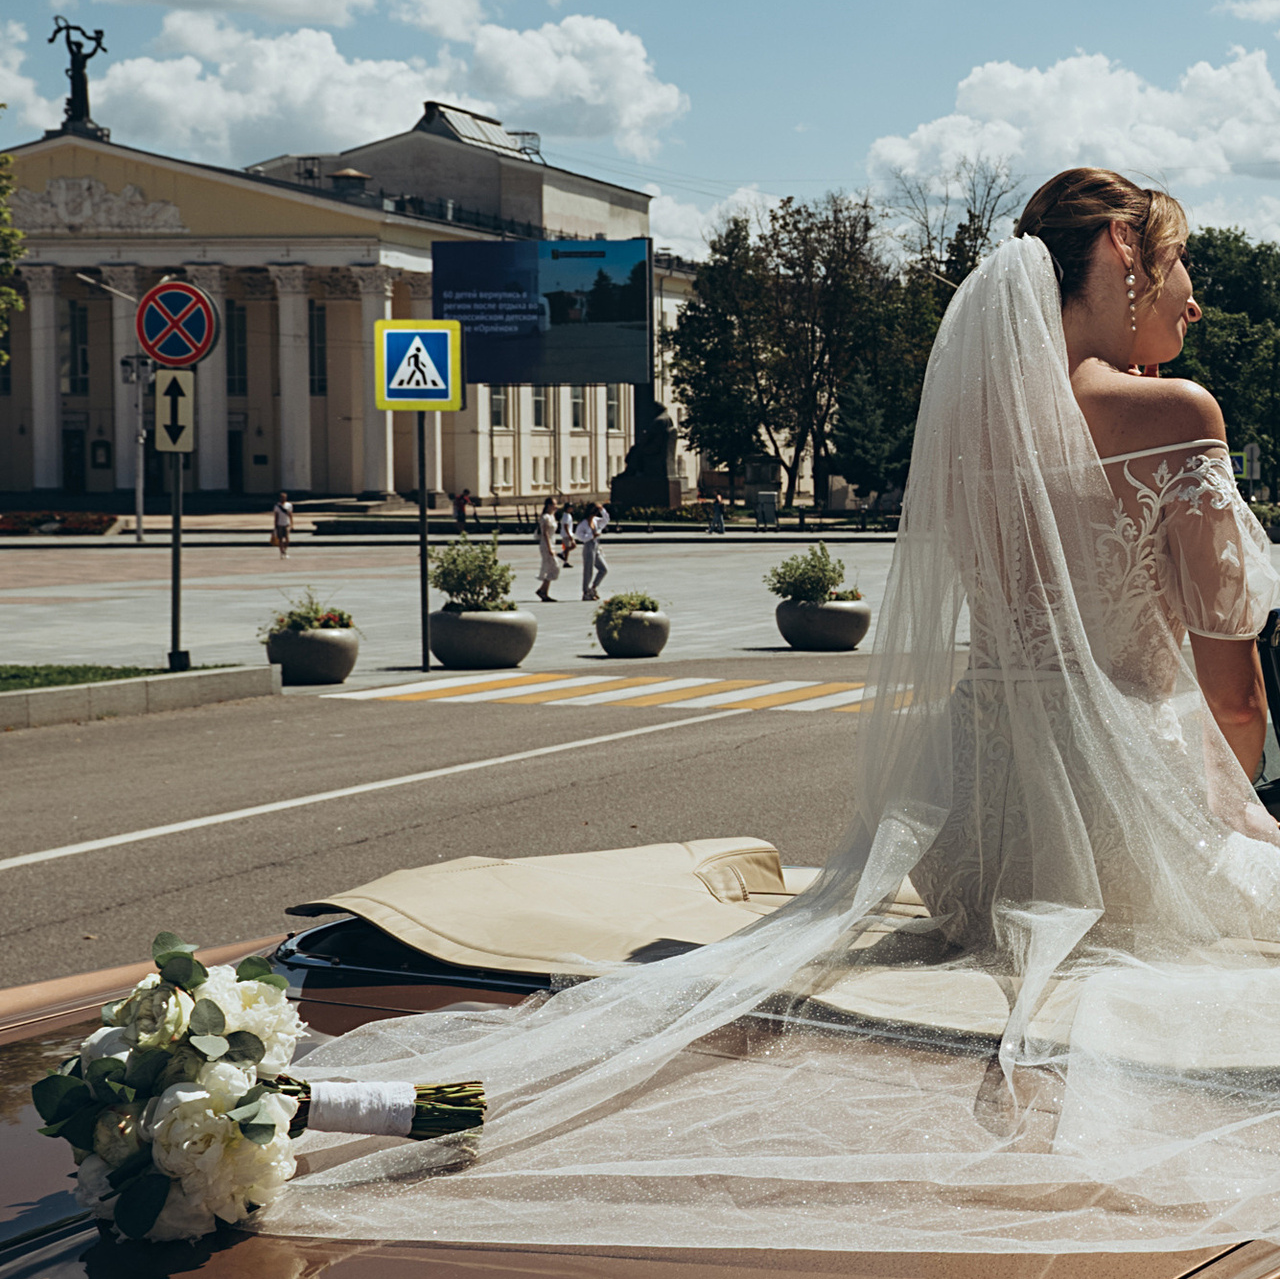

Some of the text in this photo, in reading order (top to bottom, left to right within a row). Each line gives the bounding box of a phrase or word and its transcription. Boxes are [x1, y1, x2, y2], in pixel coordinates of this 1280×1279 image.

[443, 290, 453, 299] 60
[455, 290, 478, 300] детей
[479, 291, 521, 300] вернулись
[443, 303, 472, 311] регион
[498, 303, 527, 311] отдыха
[505, 314, 538, 322] детском
